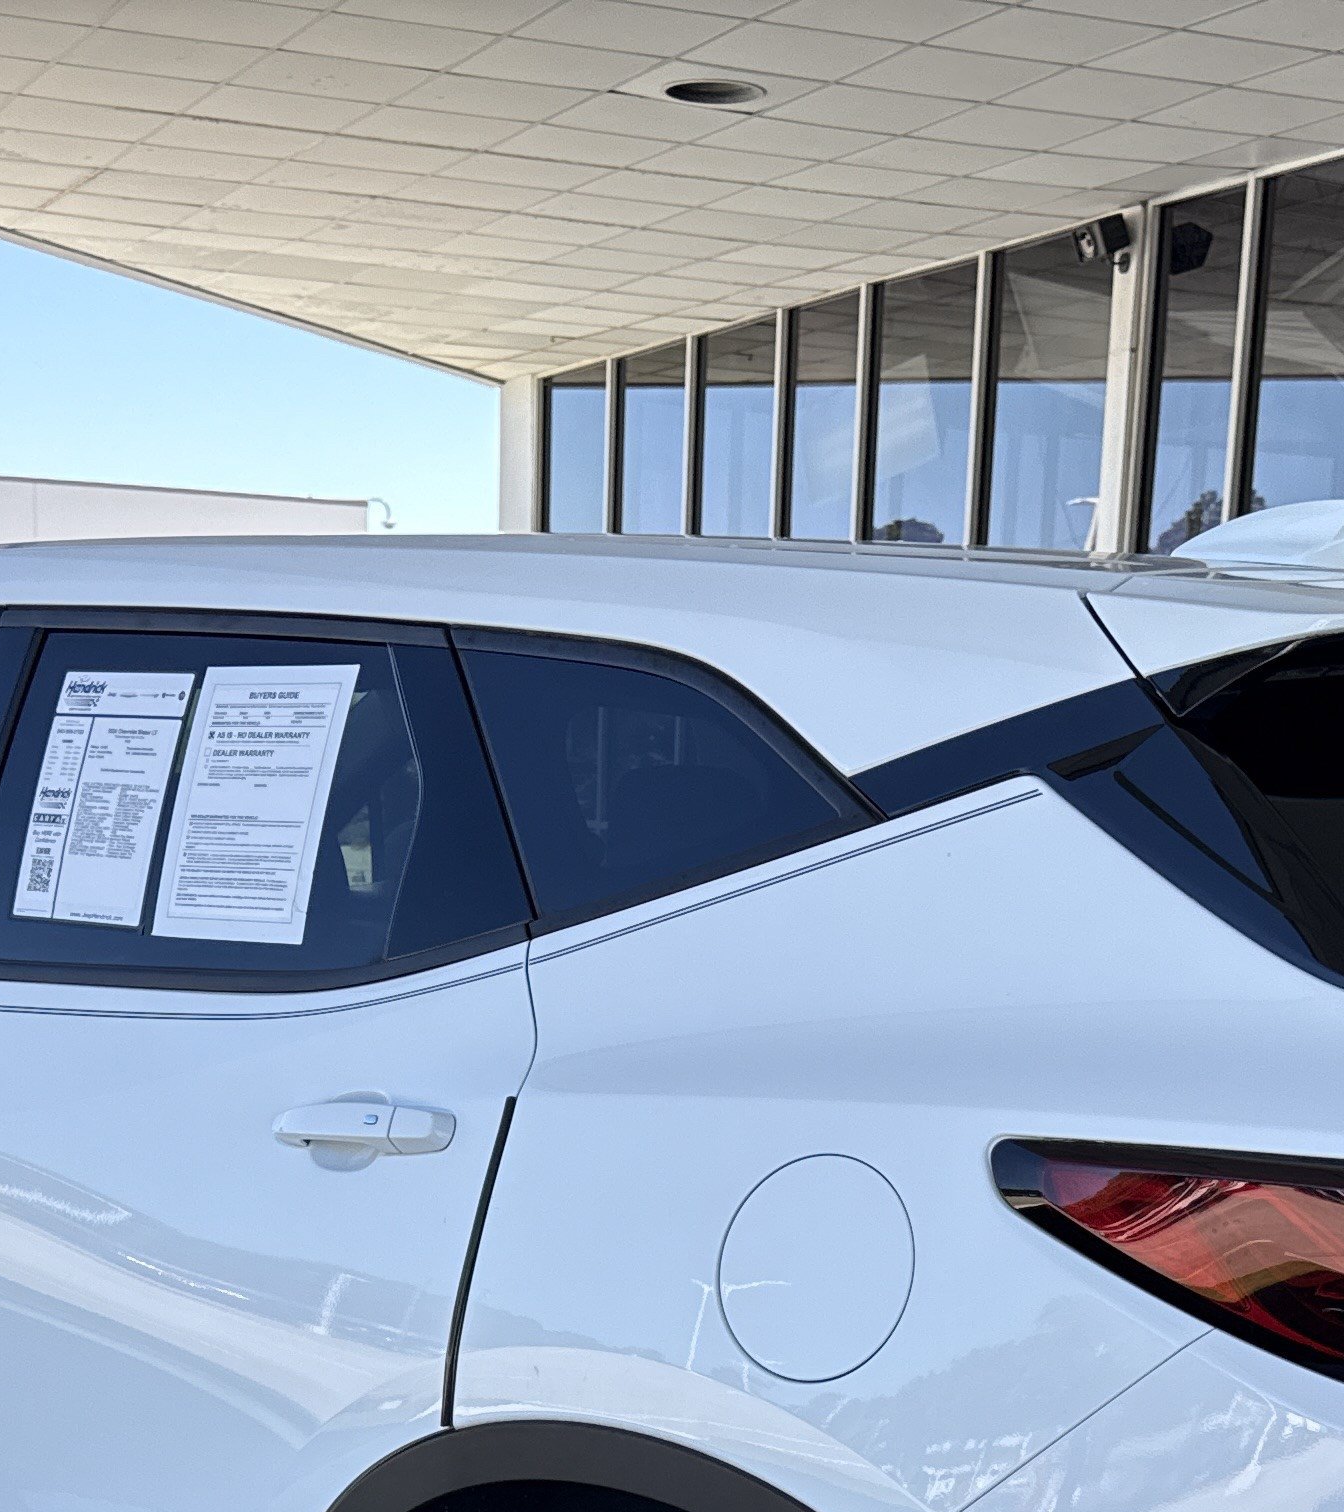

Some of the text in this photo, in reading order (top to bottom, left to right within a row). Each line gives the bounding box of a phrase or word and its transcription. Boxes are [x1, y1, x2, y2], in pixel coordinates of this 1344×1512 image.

[248, 691, 300, 700] BUYERS GUIDE
[248, 731, 273, 739] DEALER
[212, 749, 275, 758] DEALER WARRANTY
